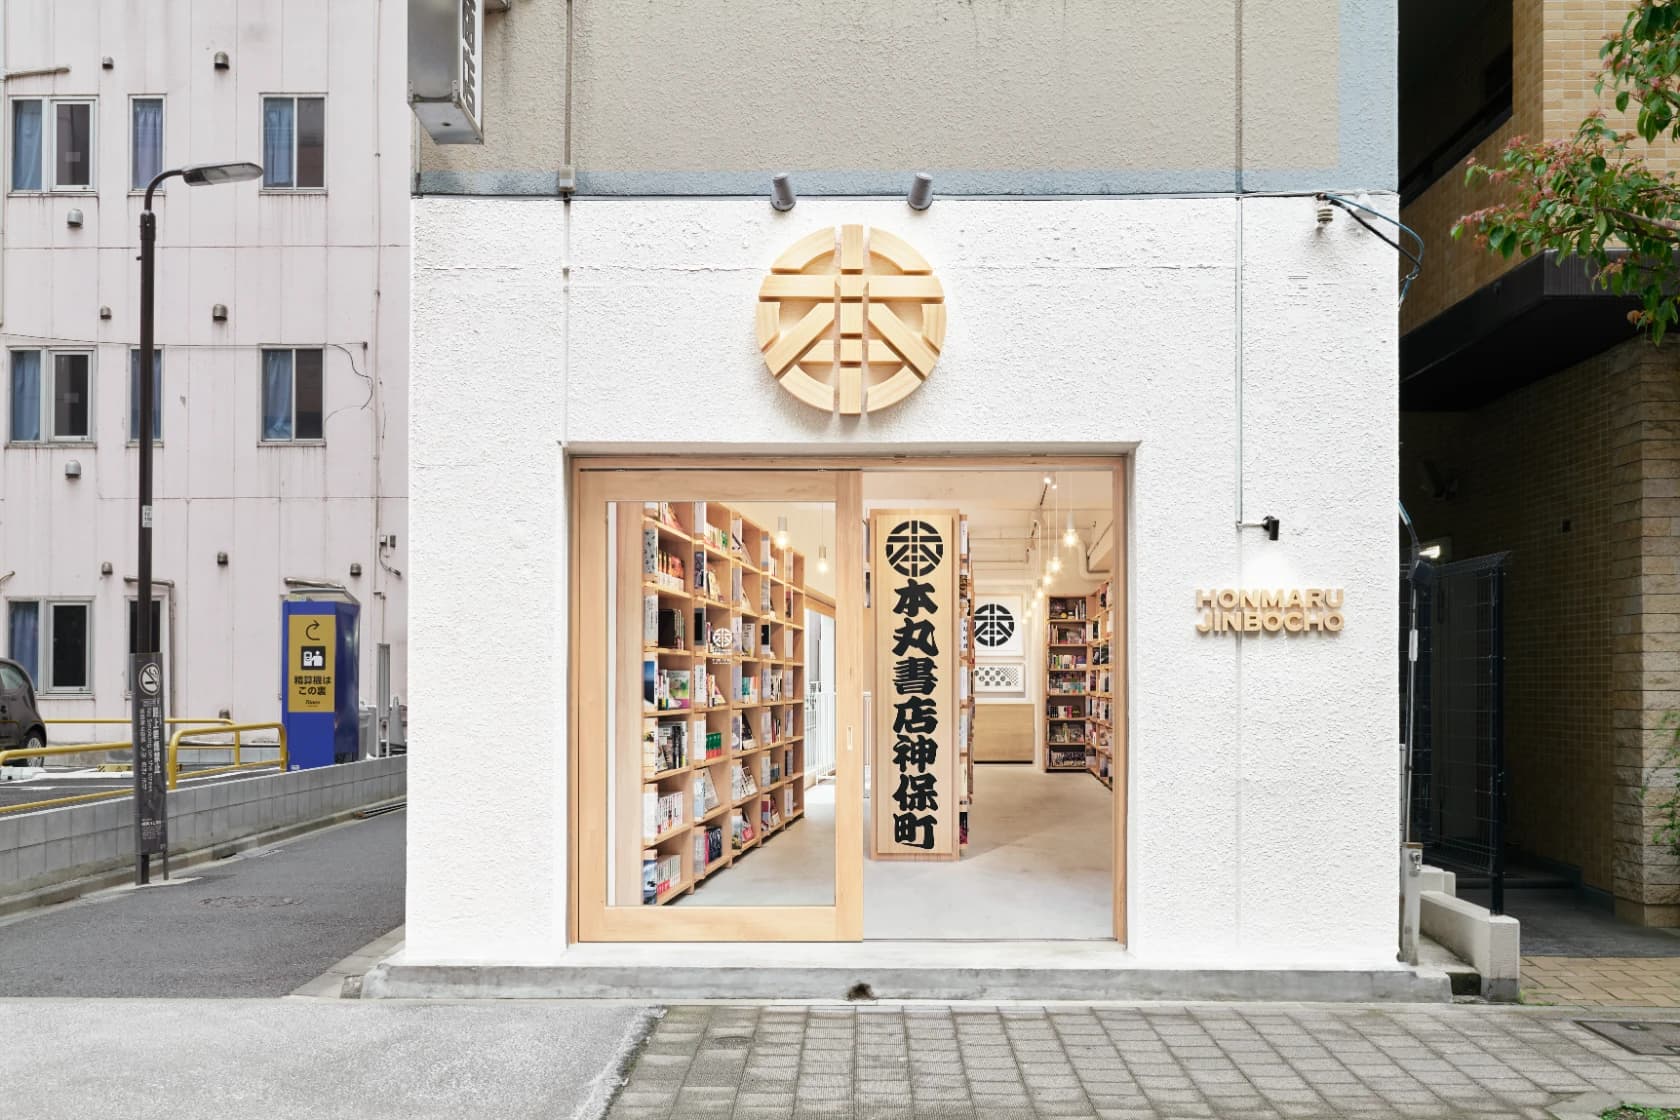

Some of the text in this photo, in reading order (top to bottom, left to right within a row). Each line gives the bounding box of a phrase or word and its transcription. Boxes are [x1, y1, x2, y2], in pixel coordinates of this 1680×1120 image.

[1195, 588, 1344, 608] HONMARU
[1195, 611, 1344, 632] JINBOCHO
[298, 686, 327, 696] この裏
[892, 578, 939, 850] 本丸書店神保町
